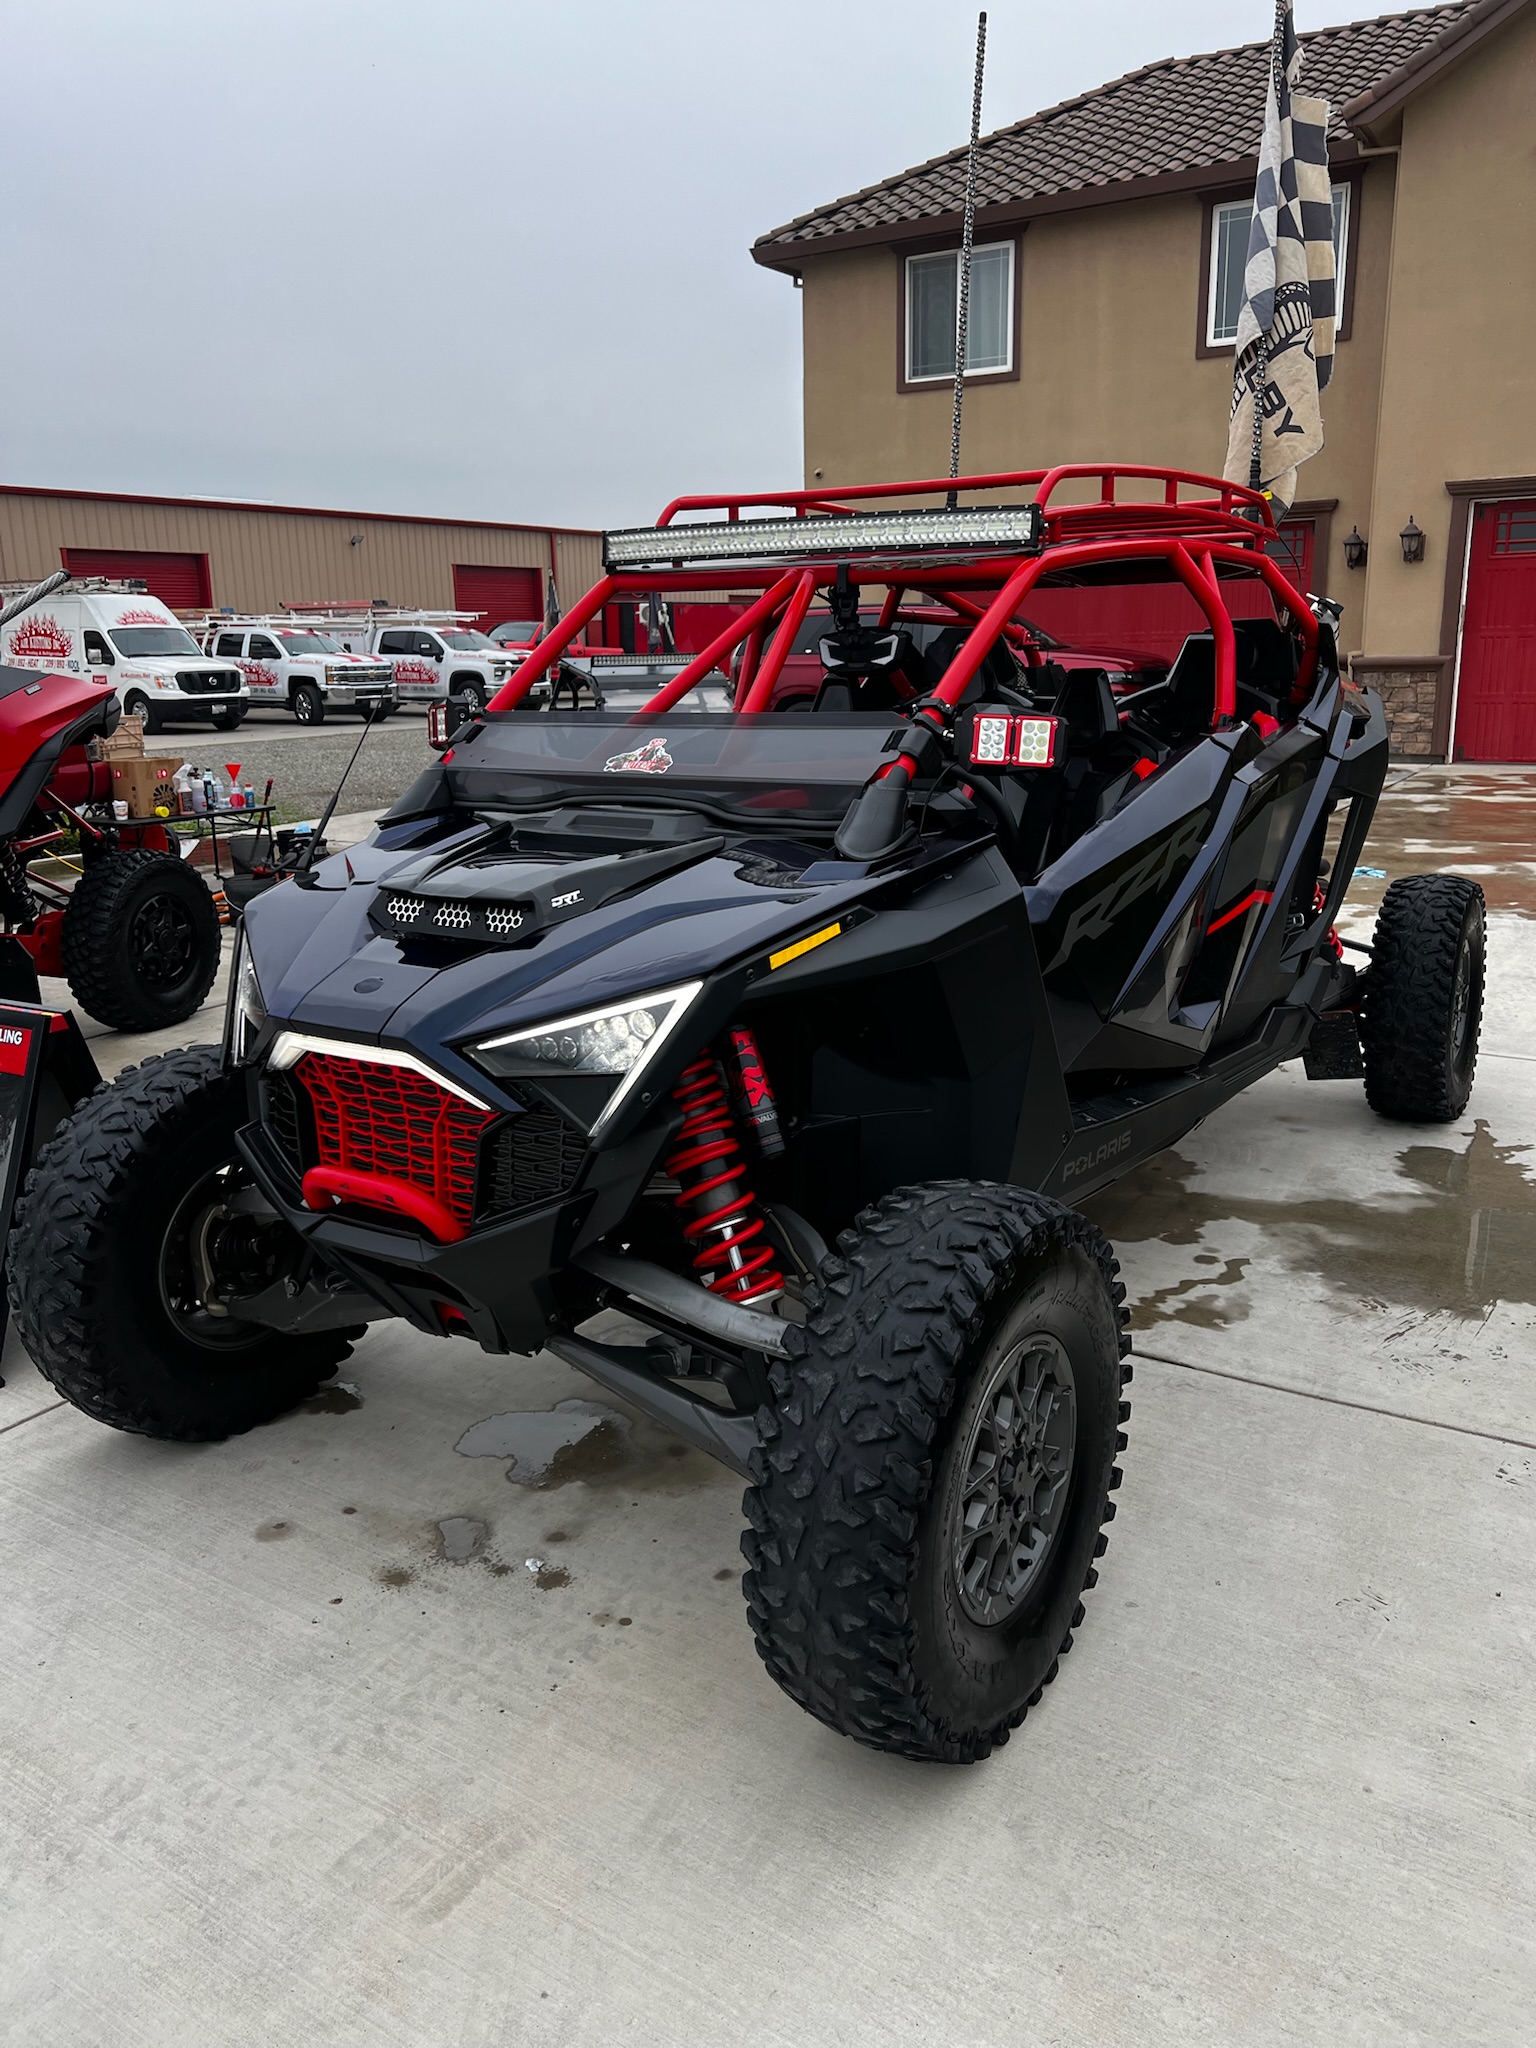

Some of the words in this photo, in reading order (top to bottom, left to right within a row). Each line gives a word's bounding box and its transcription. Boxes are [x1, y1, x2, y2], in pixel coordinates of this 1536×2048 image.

[29, 635, 52, 650] KUSTOMS
[52, 638, 62, 650] INC
[550, 889, 581, 908] DRT
[1041, 807, 1208, 977] RZR
[1062, 1130, 1132, 1184] POLARIS
